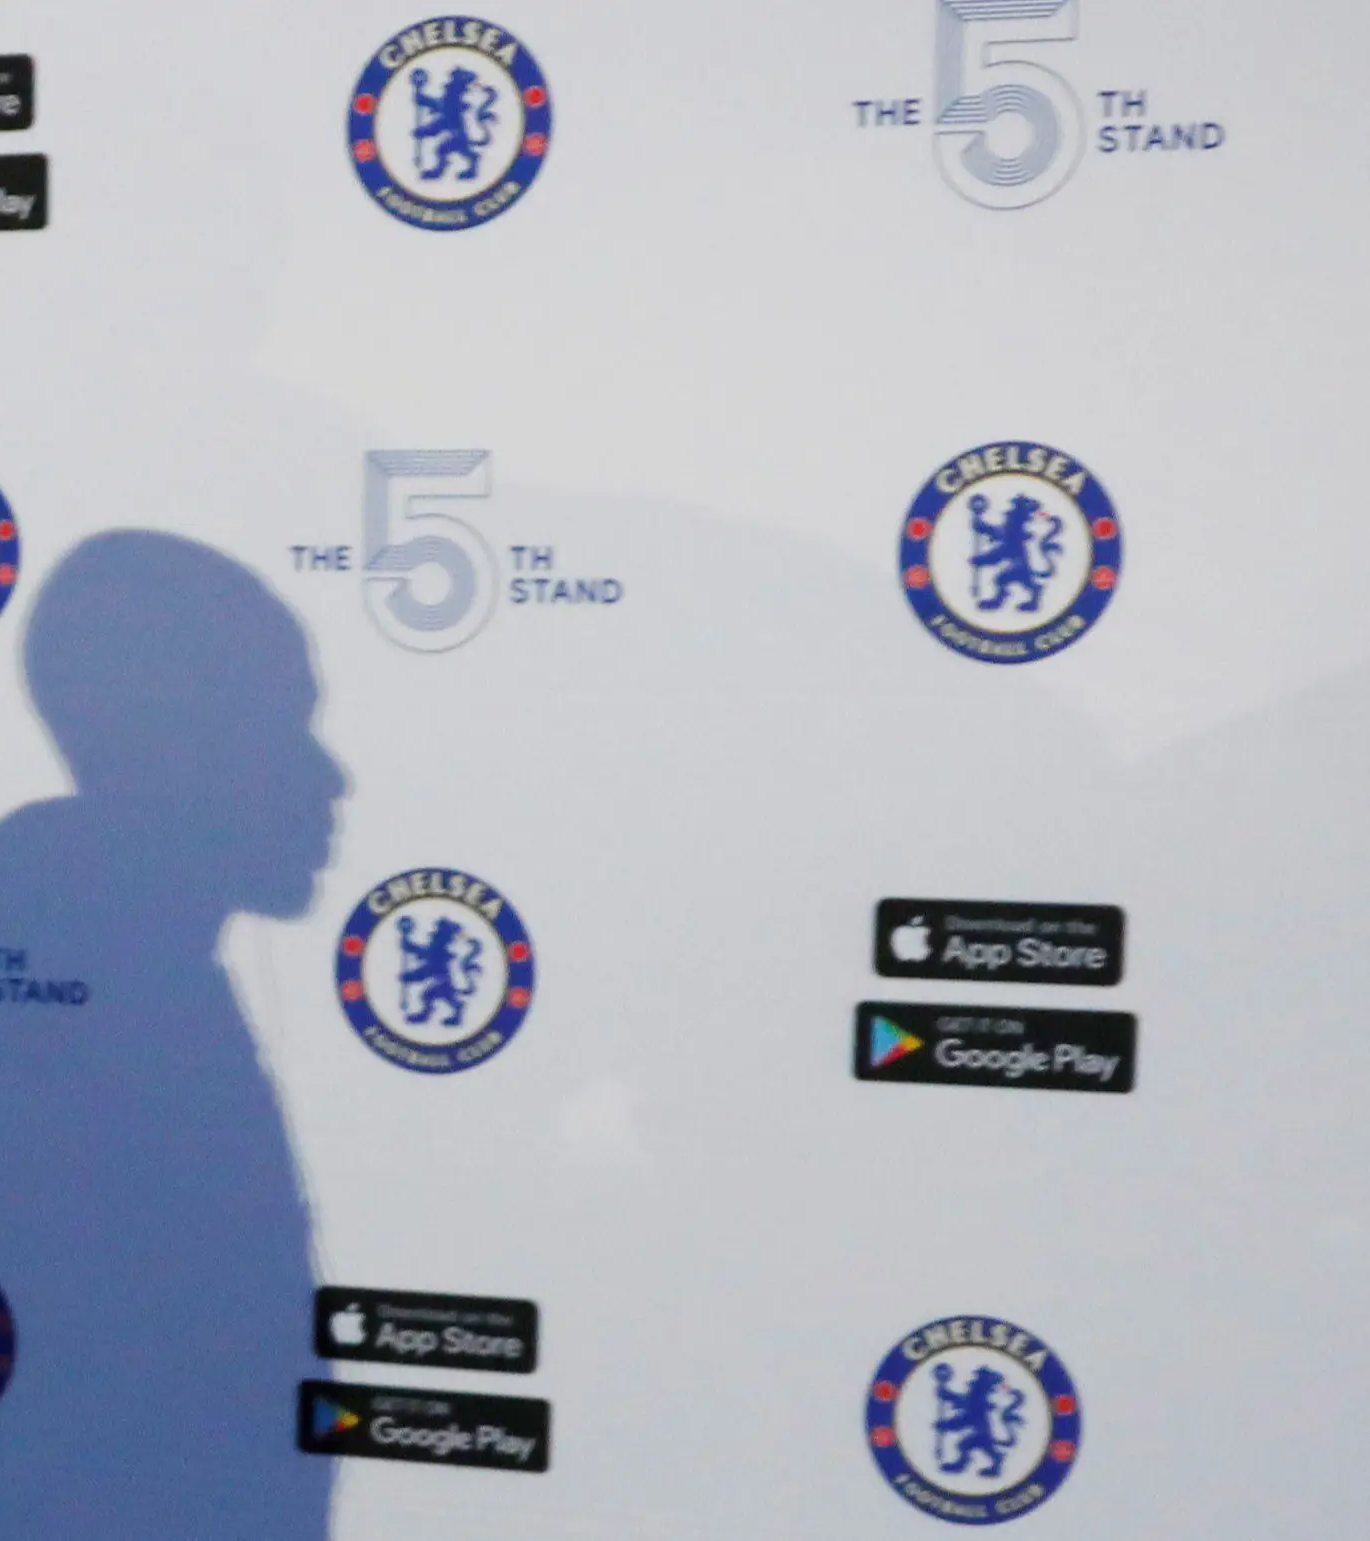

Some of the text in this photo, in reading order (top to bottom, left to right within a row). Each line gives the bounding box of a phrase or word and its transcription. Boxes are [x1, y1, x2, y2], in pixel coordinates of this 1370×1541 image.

[378, 19, 519, 69] CHELSEA
[852, 0, 1148, 211] THE 5 TH
[1096, 121, 1227, 155] STAND
[934, 445, 1089, 496] CHELSEA
[288, 449, 554, 654] THE 5 TH
[508, 576, 625, 606] STAND
[366, 871, 505, 921] CHELSEA
[940, 934, 1108, 970] App Store
[933, 1036, 1122, 1083] Google Play
[375, 1321, 525, 1359] App Store
[901, 1319, 1049, 1372] CHELSEA
[369, 1415, 537, 1465] Google Play
